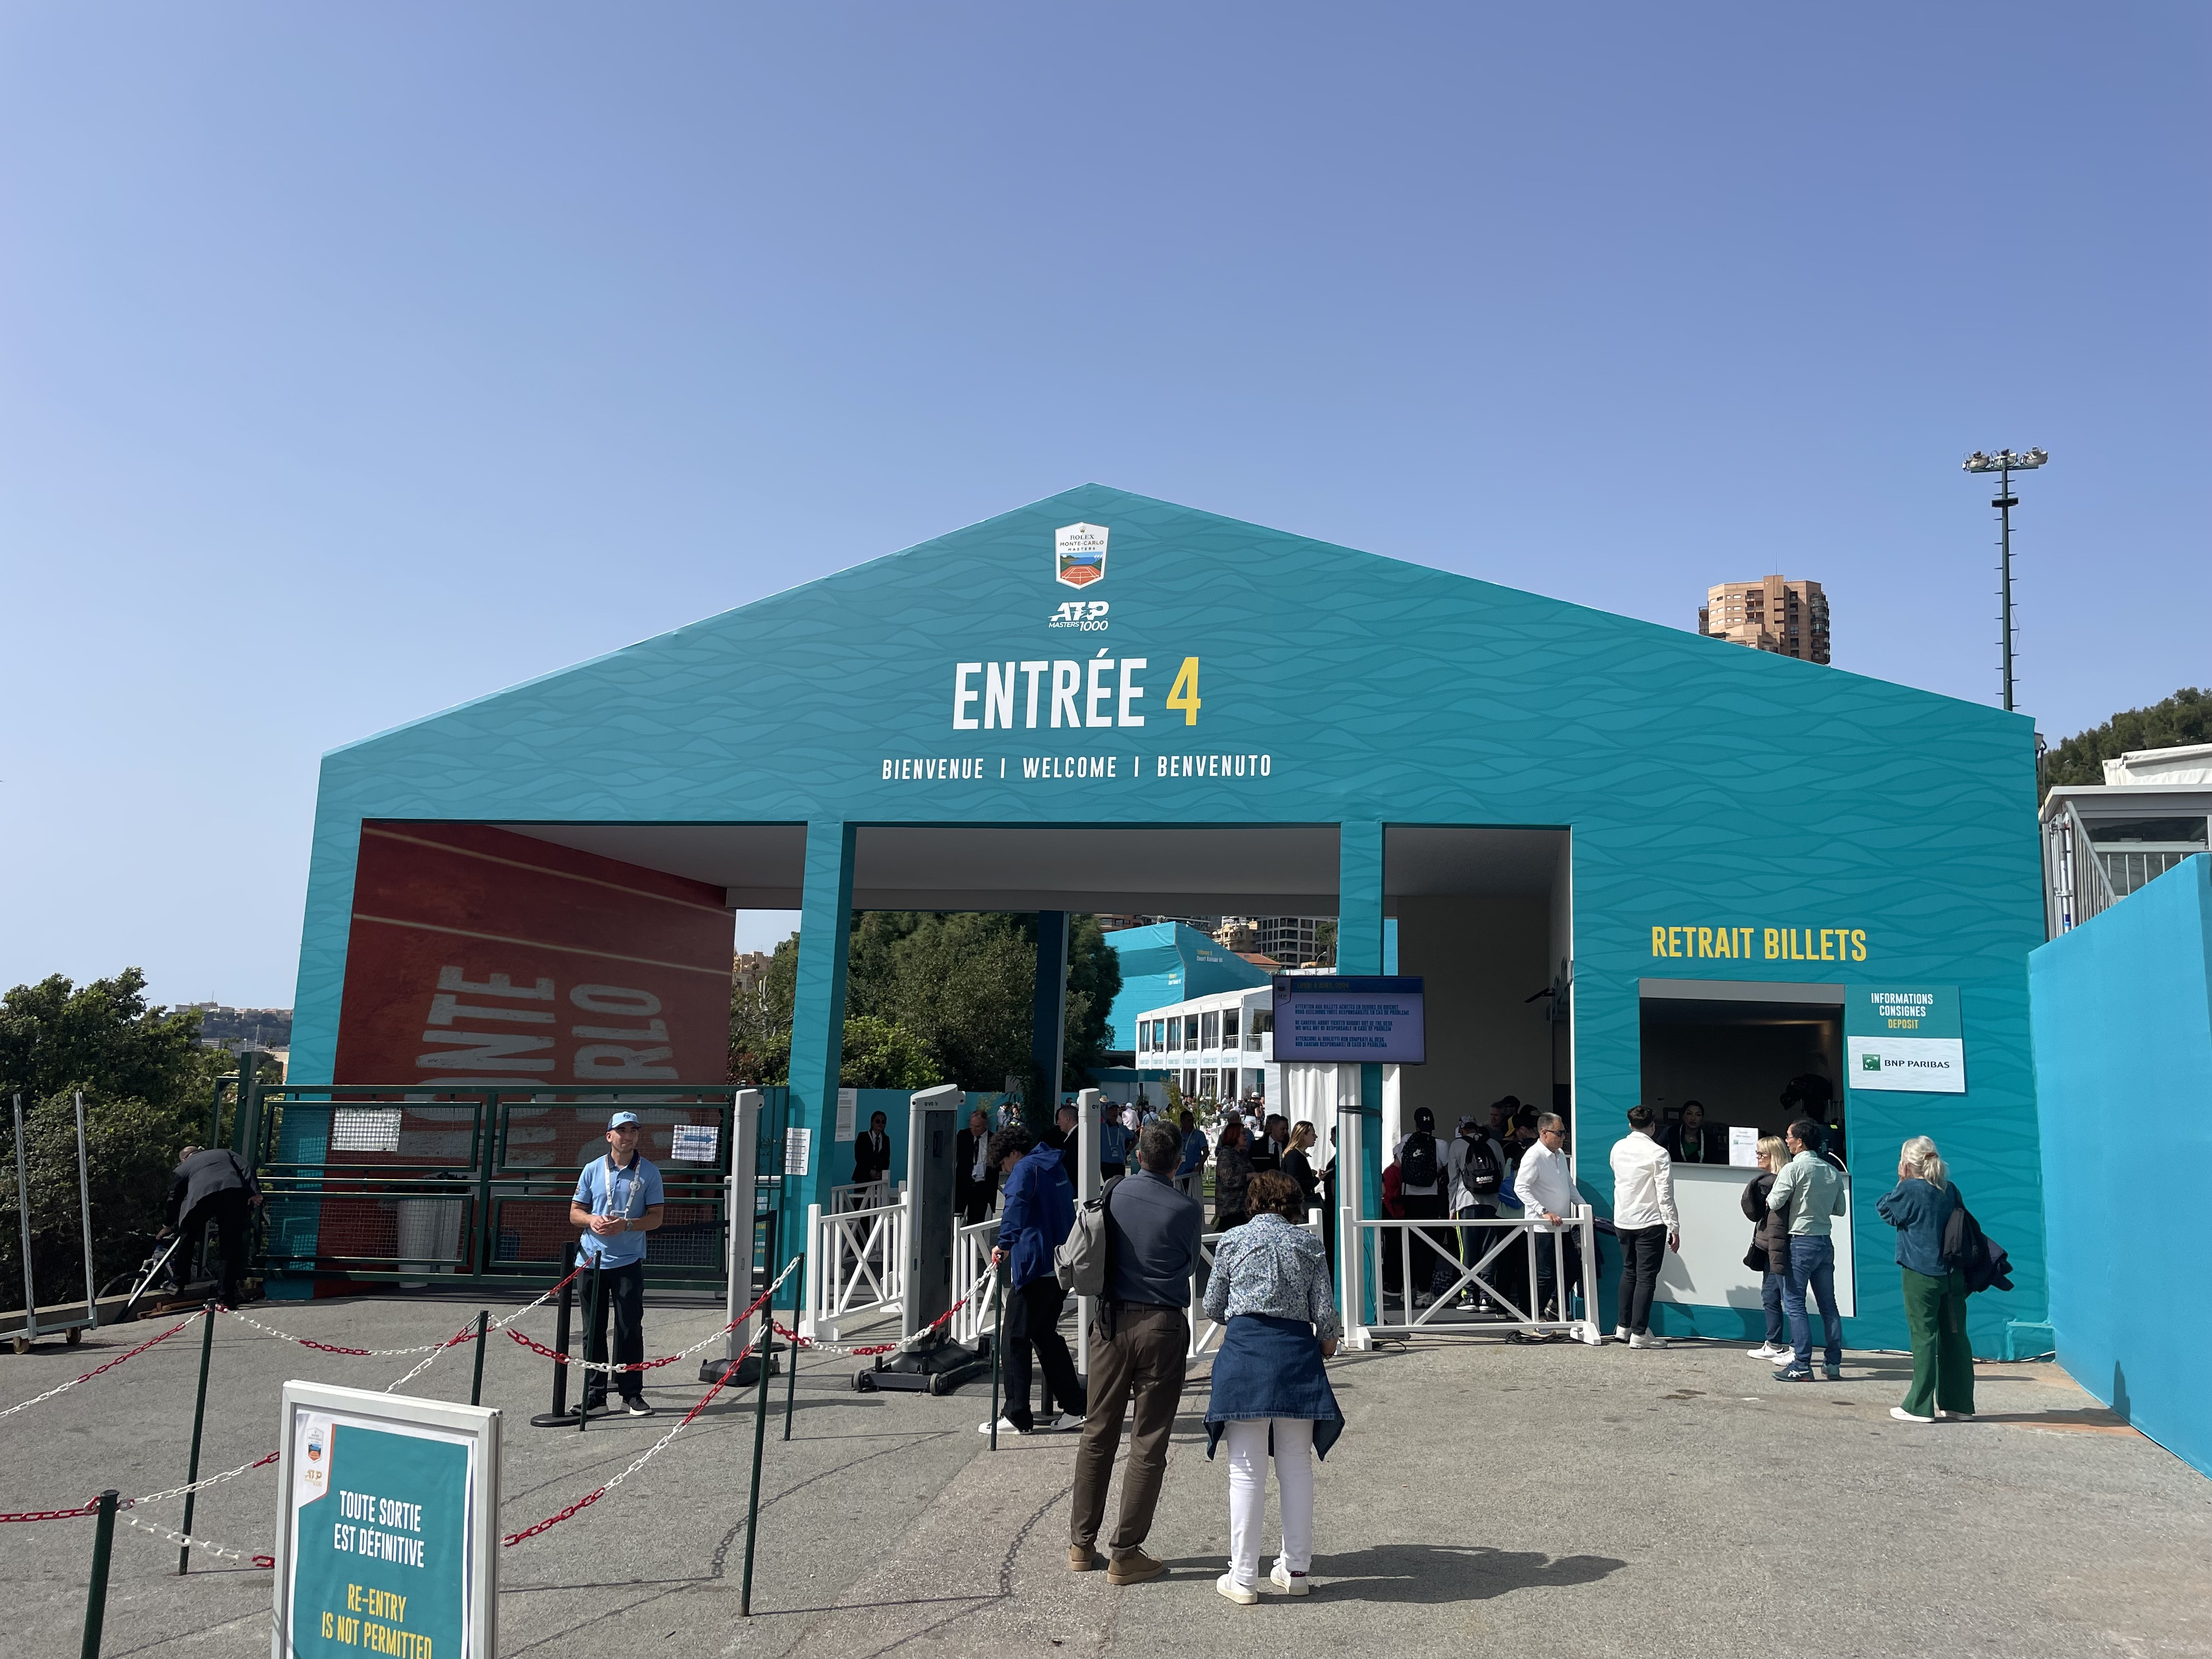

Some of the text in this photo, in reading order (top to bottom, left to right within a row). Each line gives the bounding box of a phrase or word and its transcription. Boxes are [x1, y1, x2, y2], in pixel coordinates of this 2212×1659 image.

[1047, 601, 1109, 622] ATP
[1080, 620, 1109, 631] 1000
[952, 648, 1201, 730] ENTRÉE 4
[882, 758, 984, 780] BIENVENUE
[1023, 757, 1117, 778] WELCOME
[1157, 754, 1271, 777] BENVENUTO
[1652, 926, 1867, 962] RETRAIT BILLETS
[1871, 992, 1933, 1005] INFORMATIONS
[1879, 1005, 1926, 1017] CONSIGNES
[1888, 1019, 1918, 1029] DEPOSIT
[340, 1490, 422, 1532] TOUTE SORTIE
[334, 1523, 425, 1568] EST DÉFINITIVE
[347, 1583, 407, 1623] RE-ENTRY
[321, 1611, 432, 1659] IS NOT PERMITTED
